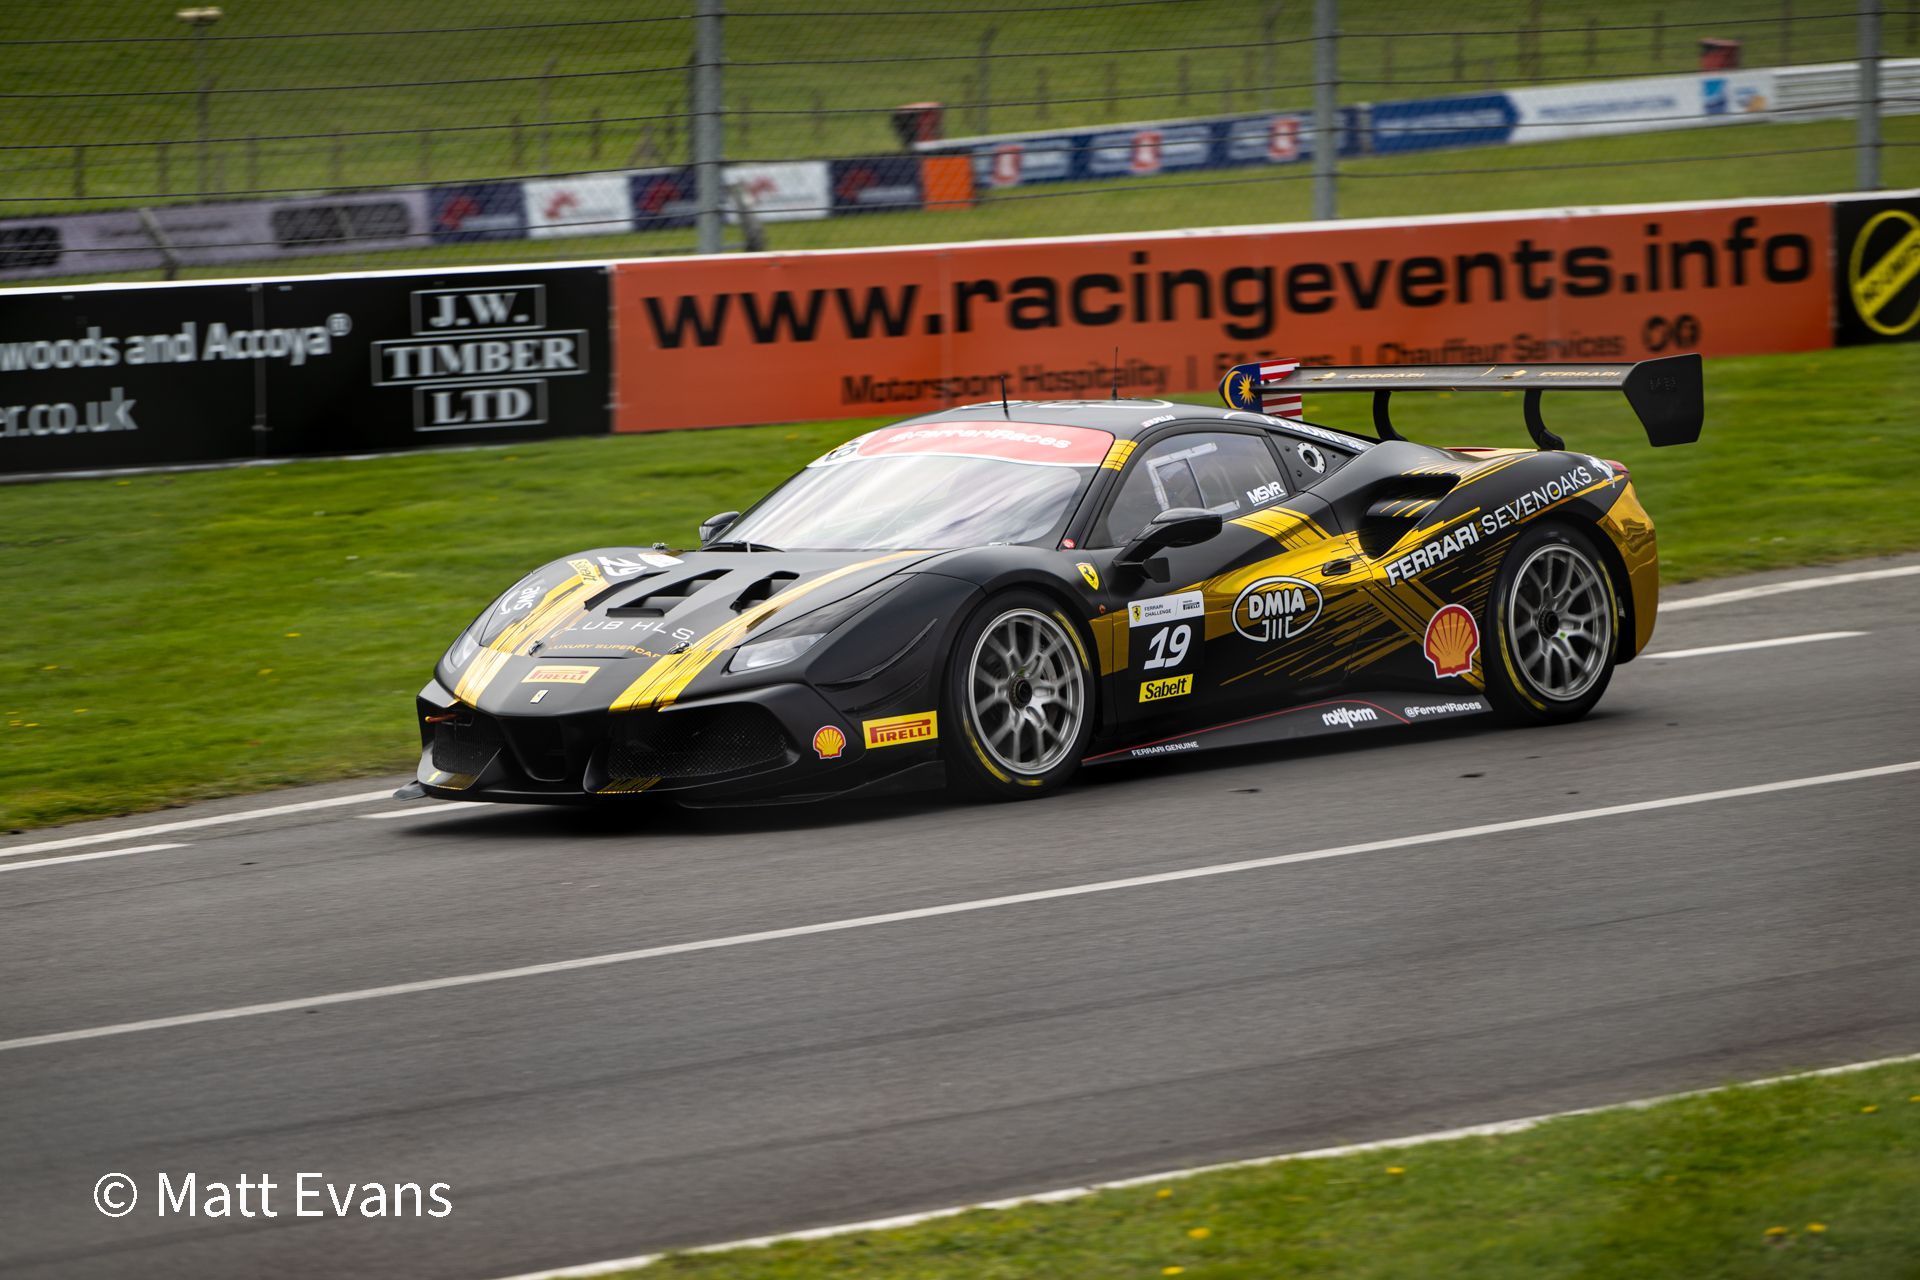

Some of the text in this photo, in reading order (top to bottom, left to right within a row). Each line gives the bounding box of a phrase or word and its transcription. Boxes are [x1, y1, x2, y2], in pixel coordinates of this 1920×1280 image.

[644, 217, 1813, 349] www.racingevents.info
[430, 292, 529, 328] J.W.
[125, 321, 197, 365] and
[383, 336, 578, 380] TIMBER
[1377, 330, 1626, 364] Chauffeur Services
[842, 371, 1011, 404] Motorsport
[1019, 358, 1170, 392] Hospitality
[431, 386, 532, 425] LTD
[1246, 481, 1284, 504] MSVR
[1385, 466, 1593, 586] FERRARI SEVENOAKS
[1144, 609, 1172, 617] CHALLENGE
[1183, 602, 1200, 610] PIRELLI
[1249, 588, 1306, 619] DMIA
[1143, 624, 1192, 670] 19
[528, 669, 590, 681] PIRELLI
[1144, 678, 1188, 701] Sabelt
[1321, 707, 1378, 728] rotiform
[1404, 701, 1482, 718] @FerrariRaces
[869, 719, 932, 744] PIRELLI
[1131, 741, 1199, 757] FERRARI GENUINE
